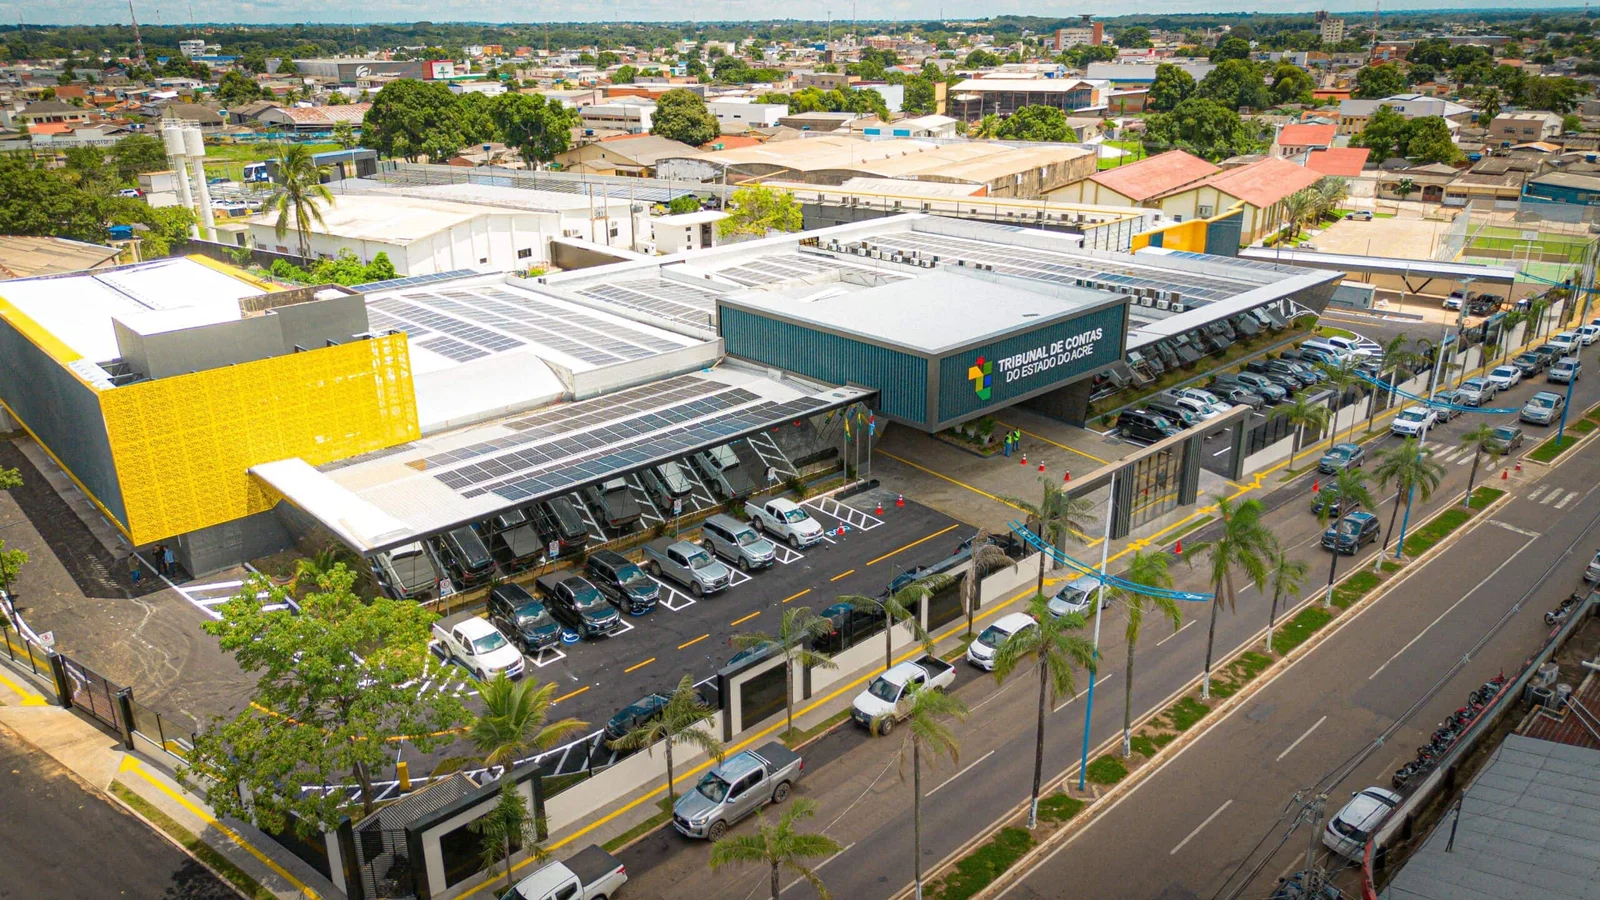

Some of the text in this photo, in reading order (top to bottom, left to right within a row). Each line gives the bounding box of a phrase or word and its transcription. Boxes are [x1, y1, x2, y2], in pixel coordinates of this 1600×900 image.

[998, 328, 1102, 372] TRIBUNAL DE CONTAS
[1006, 343, 1094, 382] DO ESTADO DO ACRE
